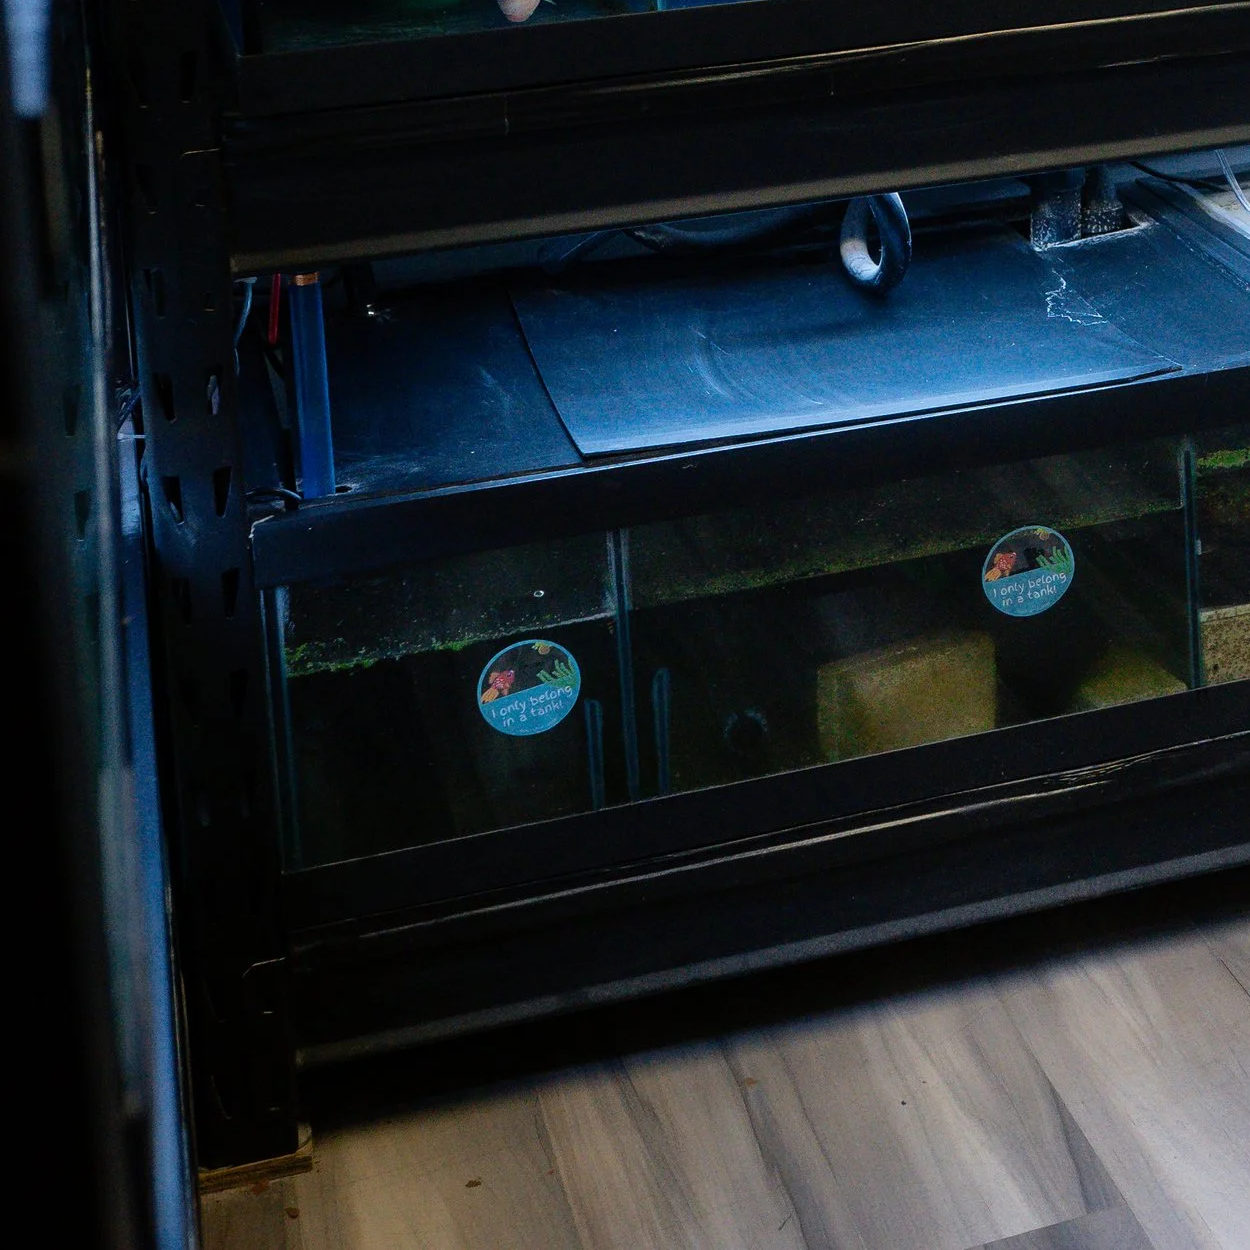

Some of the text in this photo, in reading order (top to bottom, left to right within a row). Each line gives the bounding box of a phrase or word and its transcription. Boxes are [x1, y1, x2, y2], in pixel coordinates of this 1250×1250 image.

[1000, 582, 1024, 596] only
[1028, 573, 1066, 587] belong
[1002, 597, 1013, 607] in
[1027, 585, 1057, 599] tank!
[500, 701, 526, 716] only
[530, 686, 572, 706] belong
[503, 716, 515, 727] in
[519, 714, 527, 722] a
[530, 701, 564, 716] tank!
